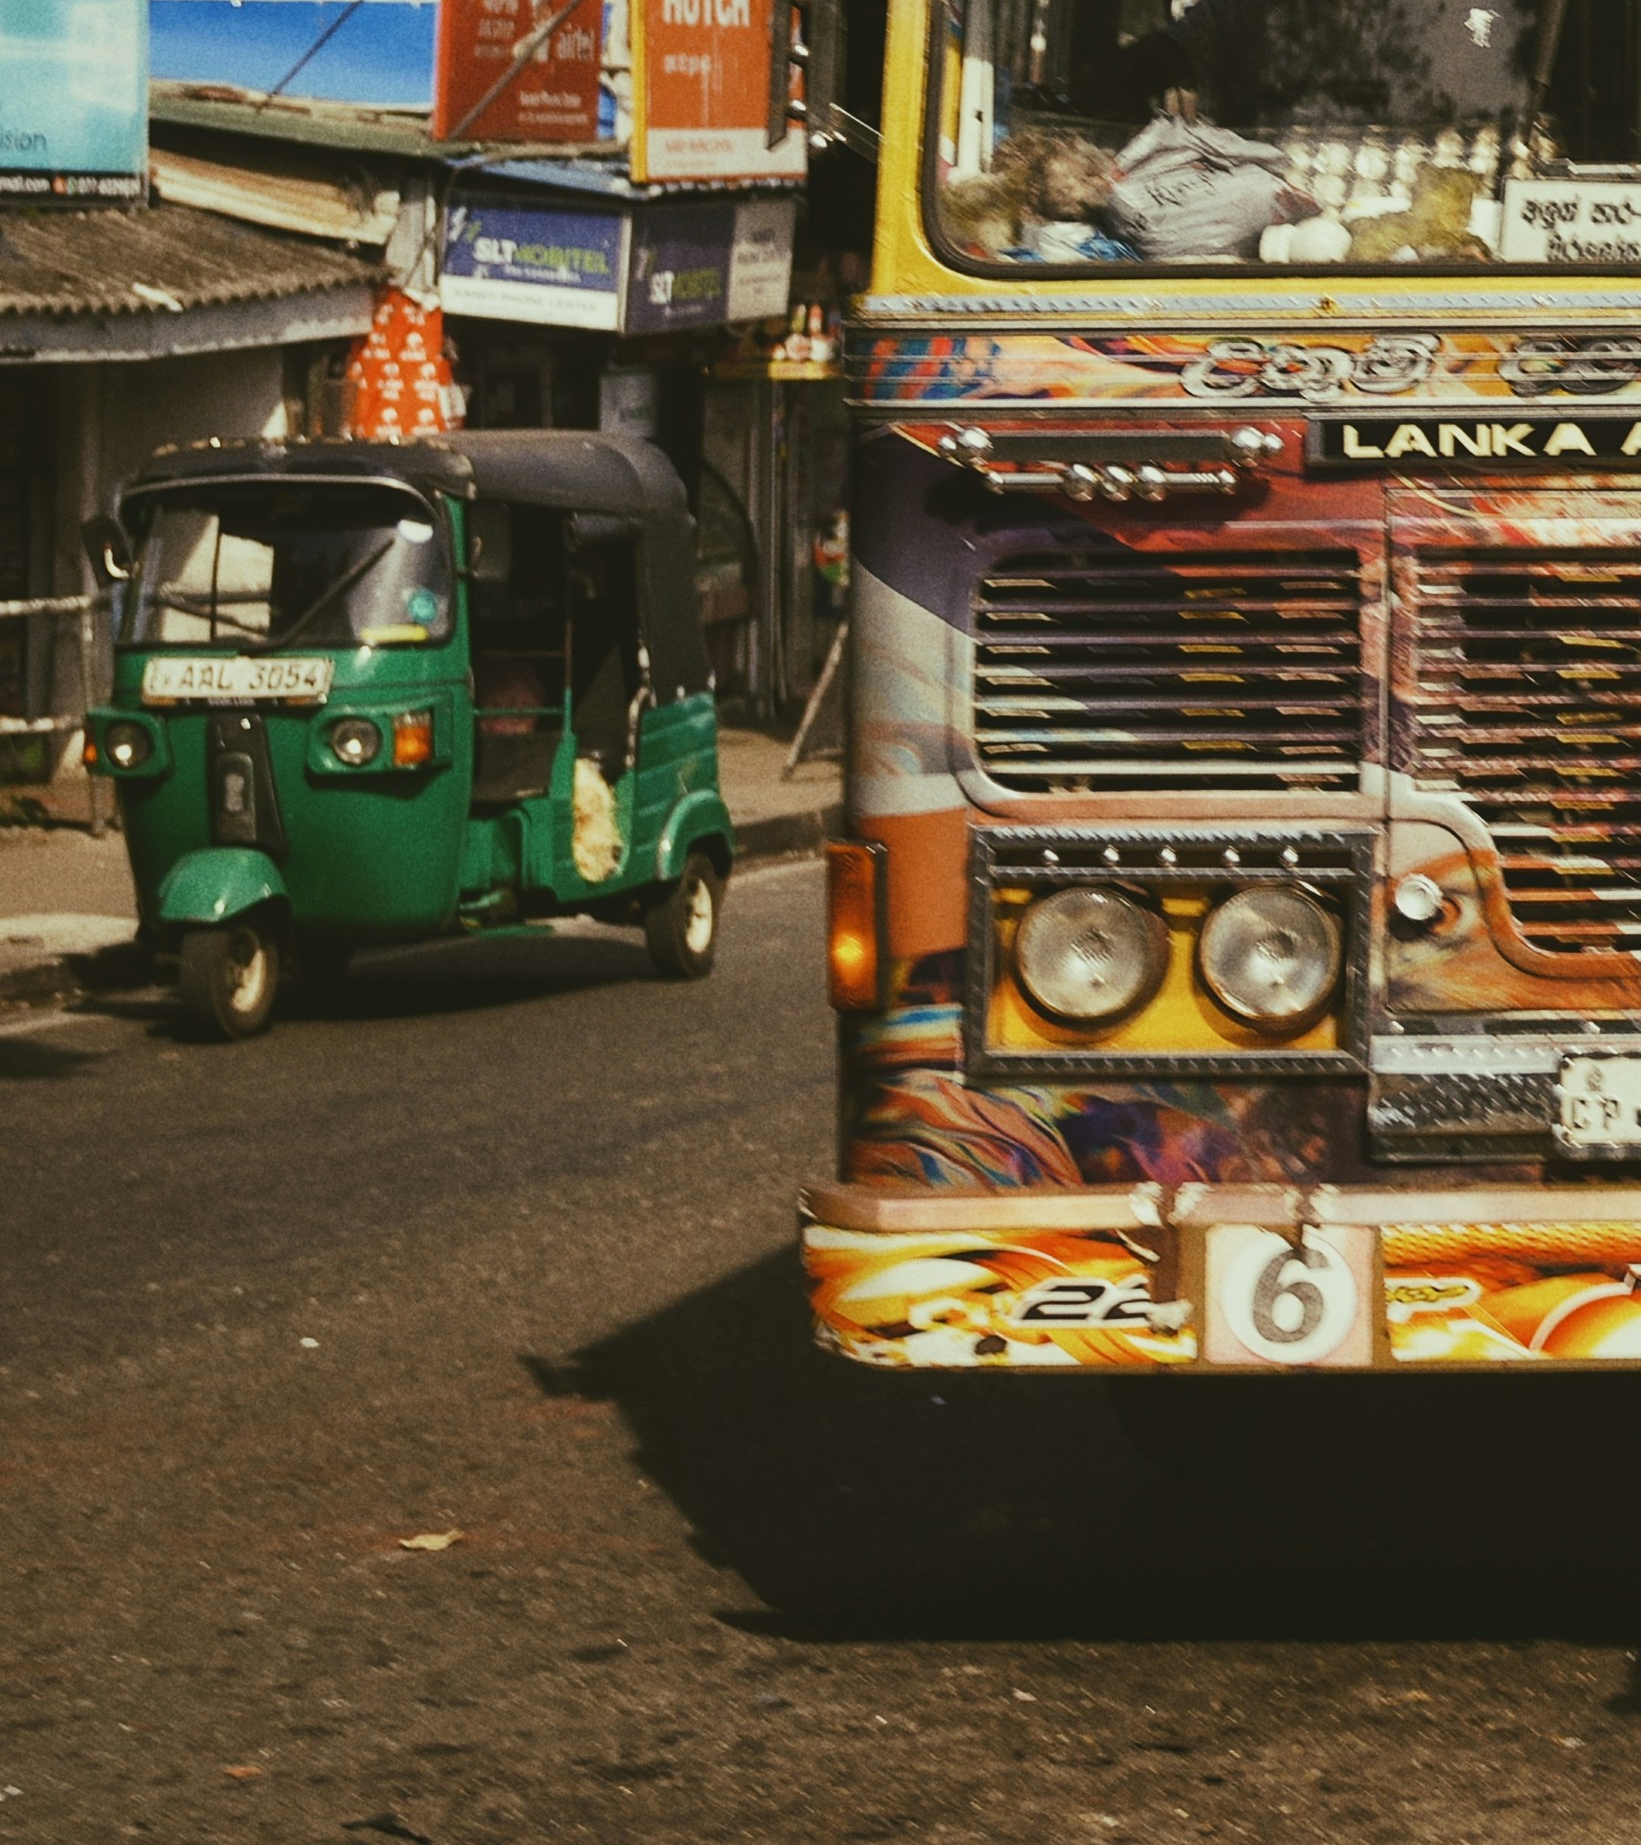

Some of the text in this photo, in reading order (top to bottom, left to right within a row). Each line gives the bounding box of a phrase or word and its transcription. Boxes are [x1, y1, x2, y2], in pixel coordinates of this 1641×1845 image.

[1343, 421, 1598, 457] LANKA
[181, 664, 232, 690] AAL
[249, 664, 318, 690] 3054
[1571, 1096, 1621, 1131] CP
[1252, 1247, 1326, 1345] 6
